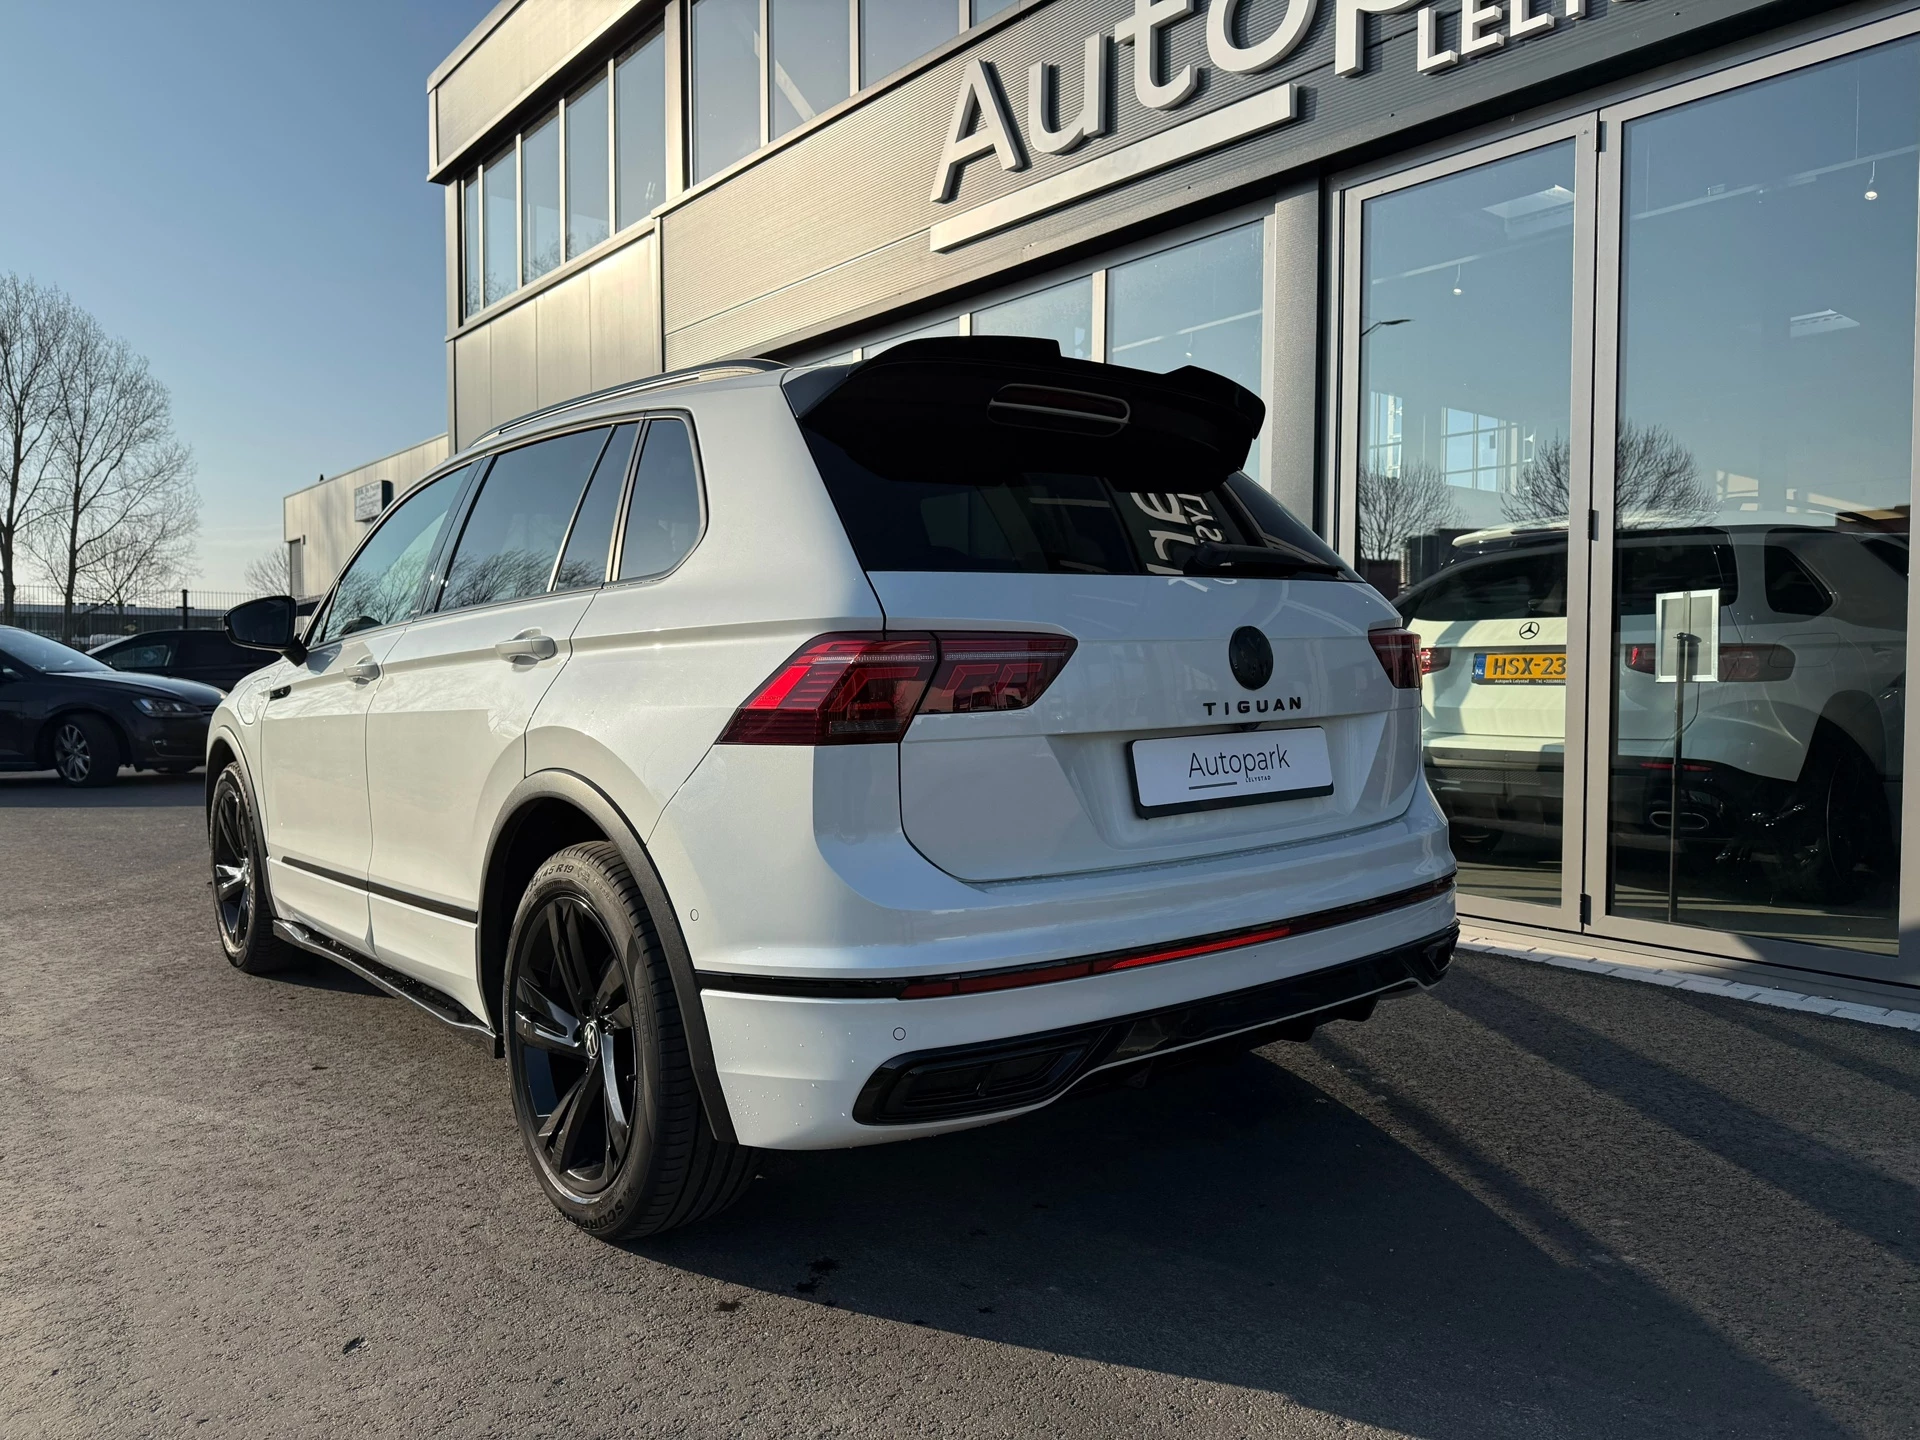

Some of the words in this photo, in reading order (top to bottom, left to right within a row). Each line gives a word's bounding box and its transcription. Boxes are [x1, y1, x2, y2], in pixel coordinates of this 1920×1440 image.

[1492, 657, 1566, 676] HSX-23
[1203, 696, 1302, 716] TIGUAN
[1188, 743, 1291, 778] Autopark
[1245, 775, 1272, 784] LELYSTAD
